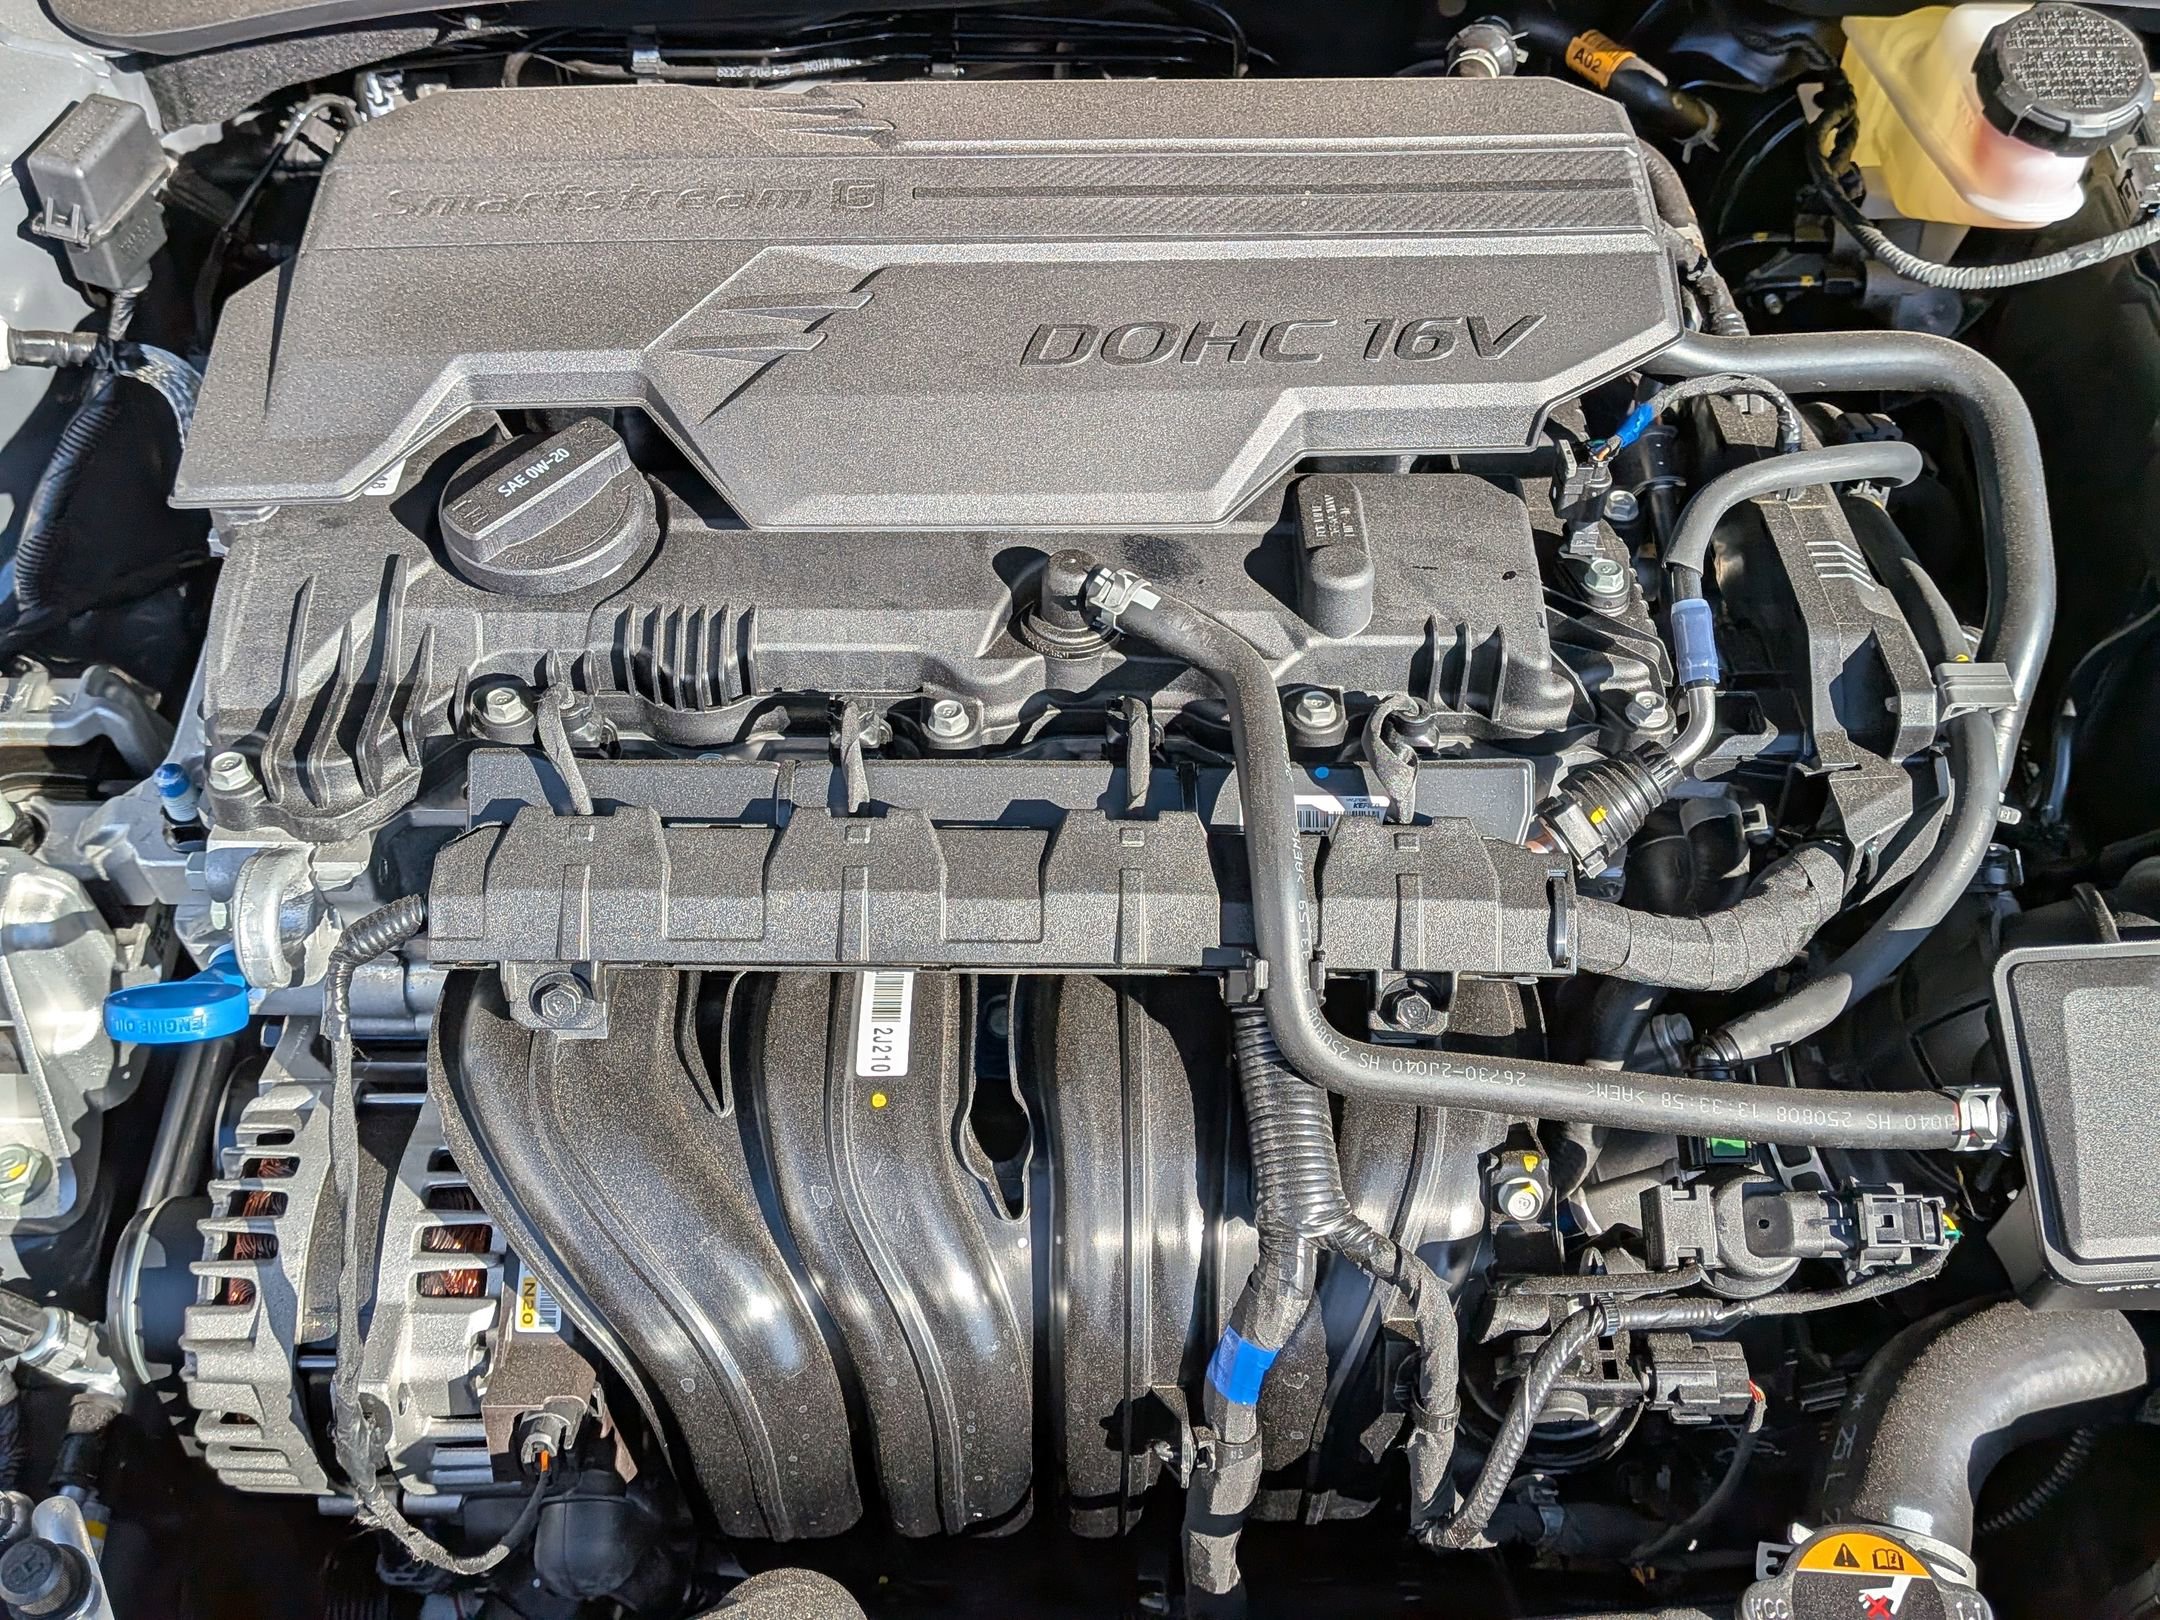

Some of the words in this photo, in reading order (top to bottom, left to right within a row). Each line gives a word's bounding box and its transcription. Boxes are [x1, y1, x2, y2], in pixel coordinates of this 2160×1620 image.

[1573, 47, 1602, 73] A02
[373, 184, 811, 217] Smartstream
[1019, 319, 1339, 368] DOHC
[1362, 314, 1549, 364] 16V
[497, 474, 529, 498] SAE
[525, 447, 570, 479] 0W-20
[138, 1015, 206, 1035] ENGINE
[1305, 1007, 1351, 1061] 250808
[870, 1027, 894, 1073] 2J210
[1358, 1052, 1381, 1071] HS
[1391, 1058, 1526, 1086] 26730-2J040
[1586, 1081, 1645, 1104] >AEM<
[1660, 1092, 1760, 1120] 13:33:58
[1776, 1107, 1853, 1129] 250808
[1866, 1113, 1891, 1131] HS
[522, 1282, 536, 1325] N20
